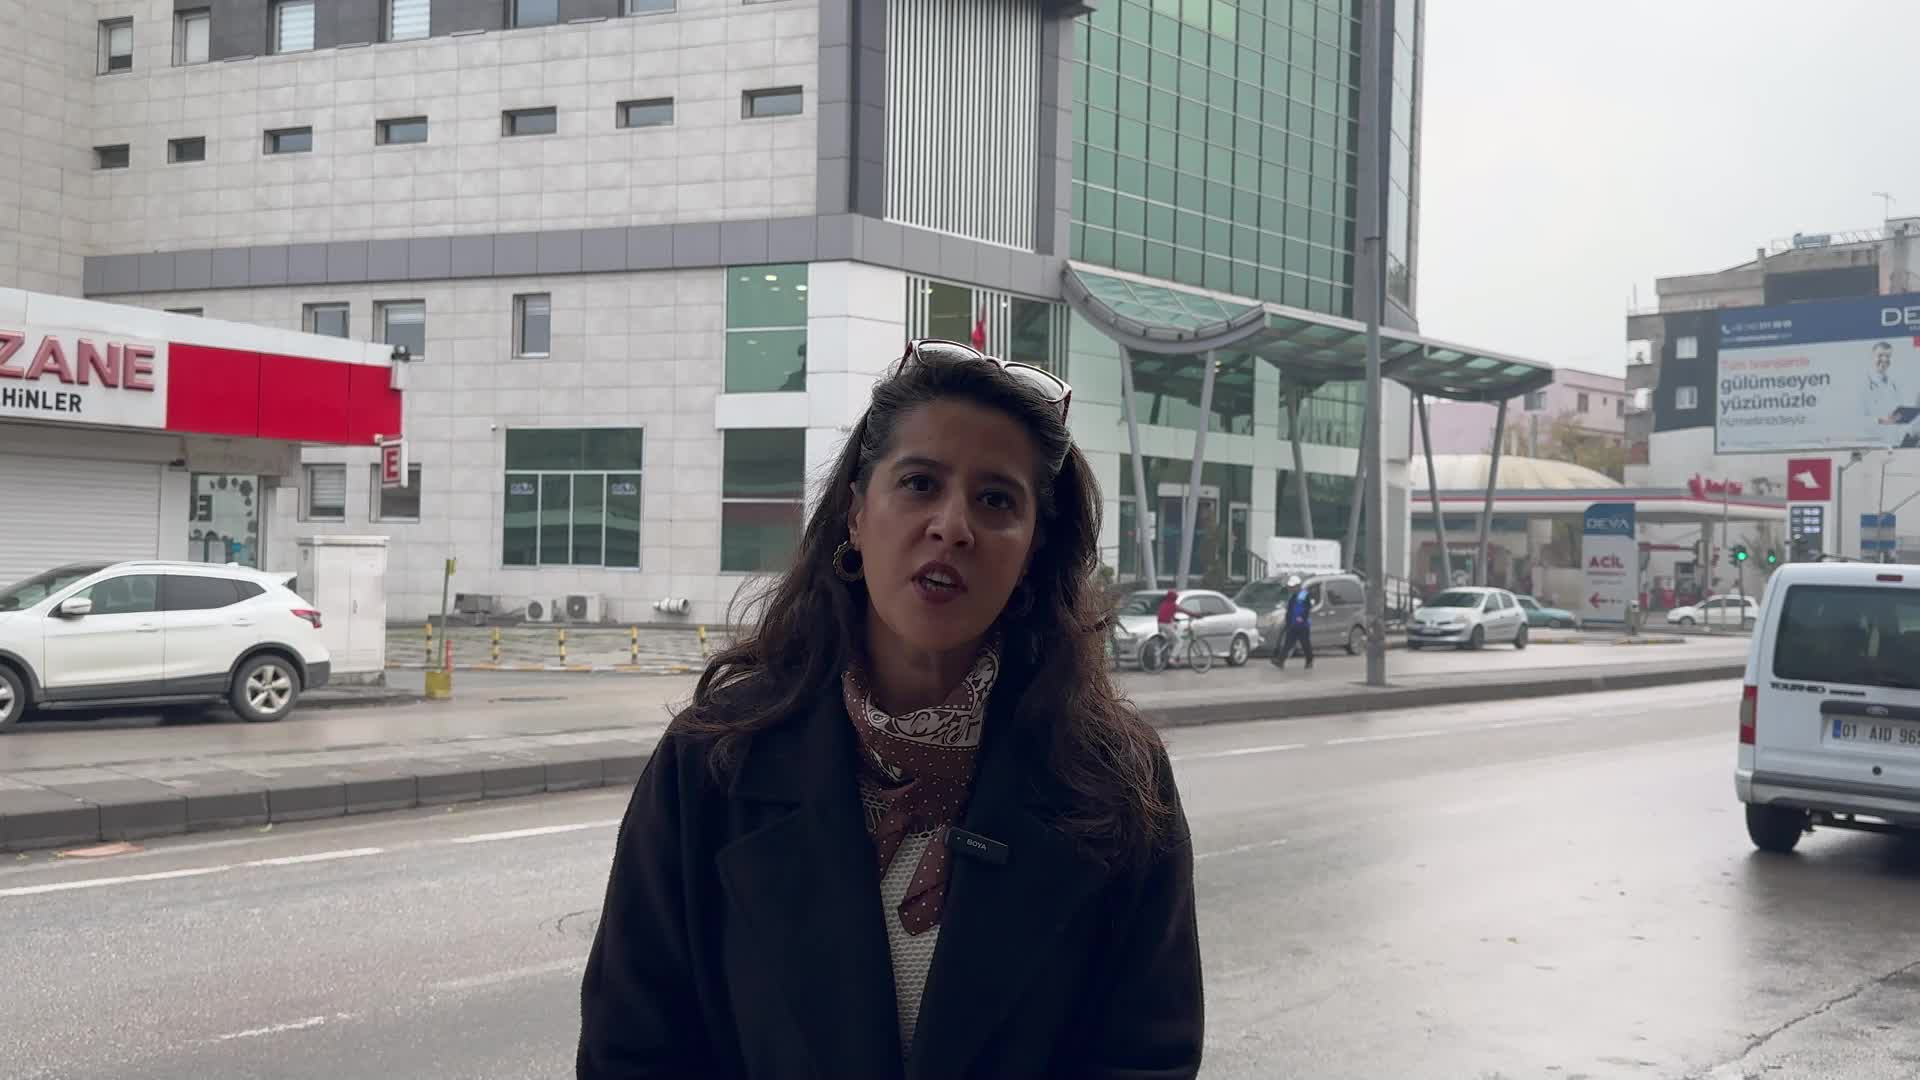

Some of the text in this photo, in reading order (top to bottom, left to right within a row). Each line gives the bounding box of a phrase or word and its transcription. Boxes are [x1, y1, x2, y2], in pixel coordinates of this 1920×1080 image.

[1721, 373, 1830, 395] gülümseyen
[1721, 392, 1817, 415] yüzümüzle
[386, 451, 399, 479] E
[1586, 517, 1630, 529] DEVA
[1843, 724, 1857, 738] 01
[1870, 725, 1892, 742] AID
[966, 838, 987, 851] BOYA
